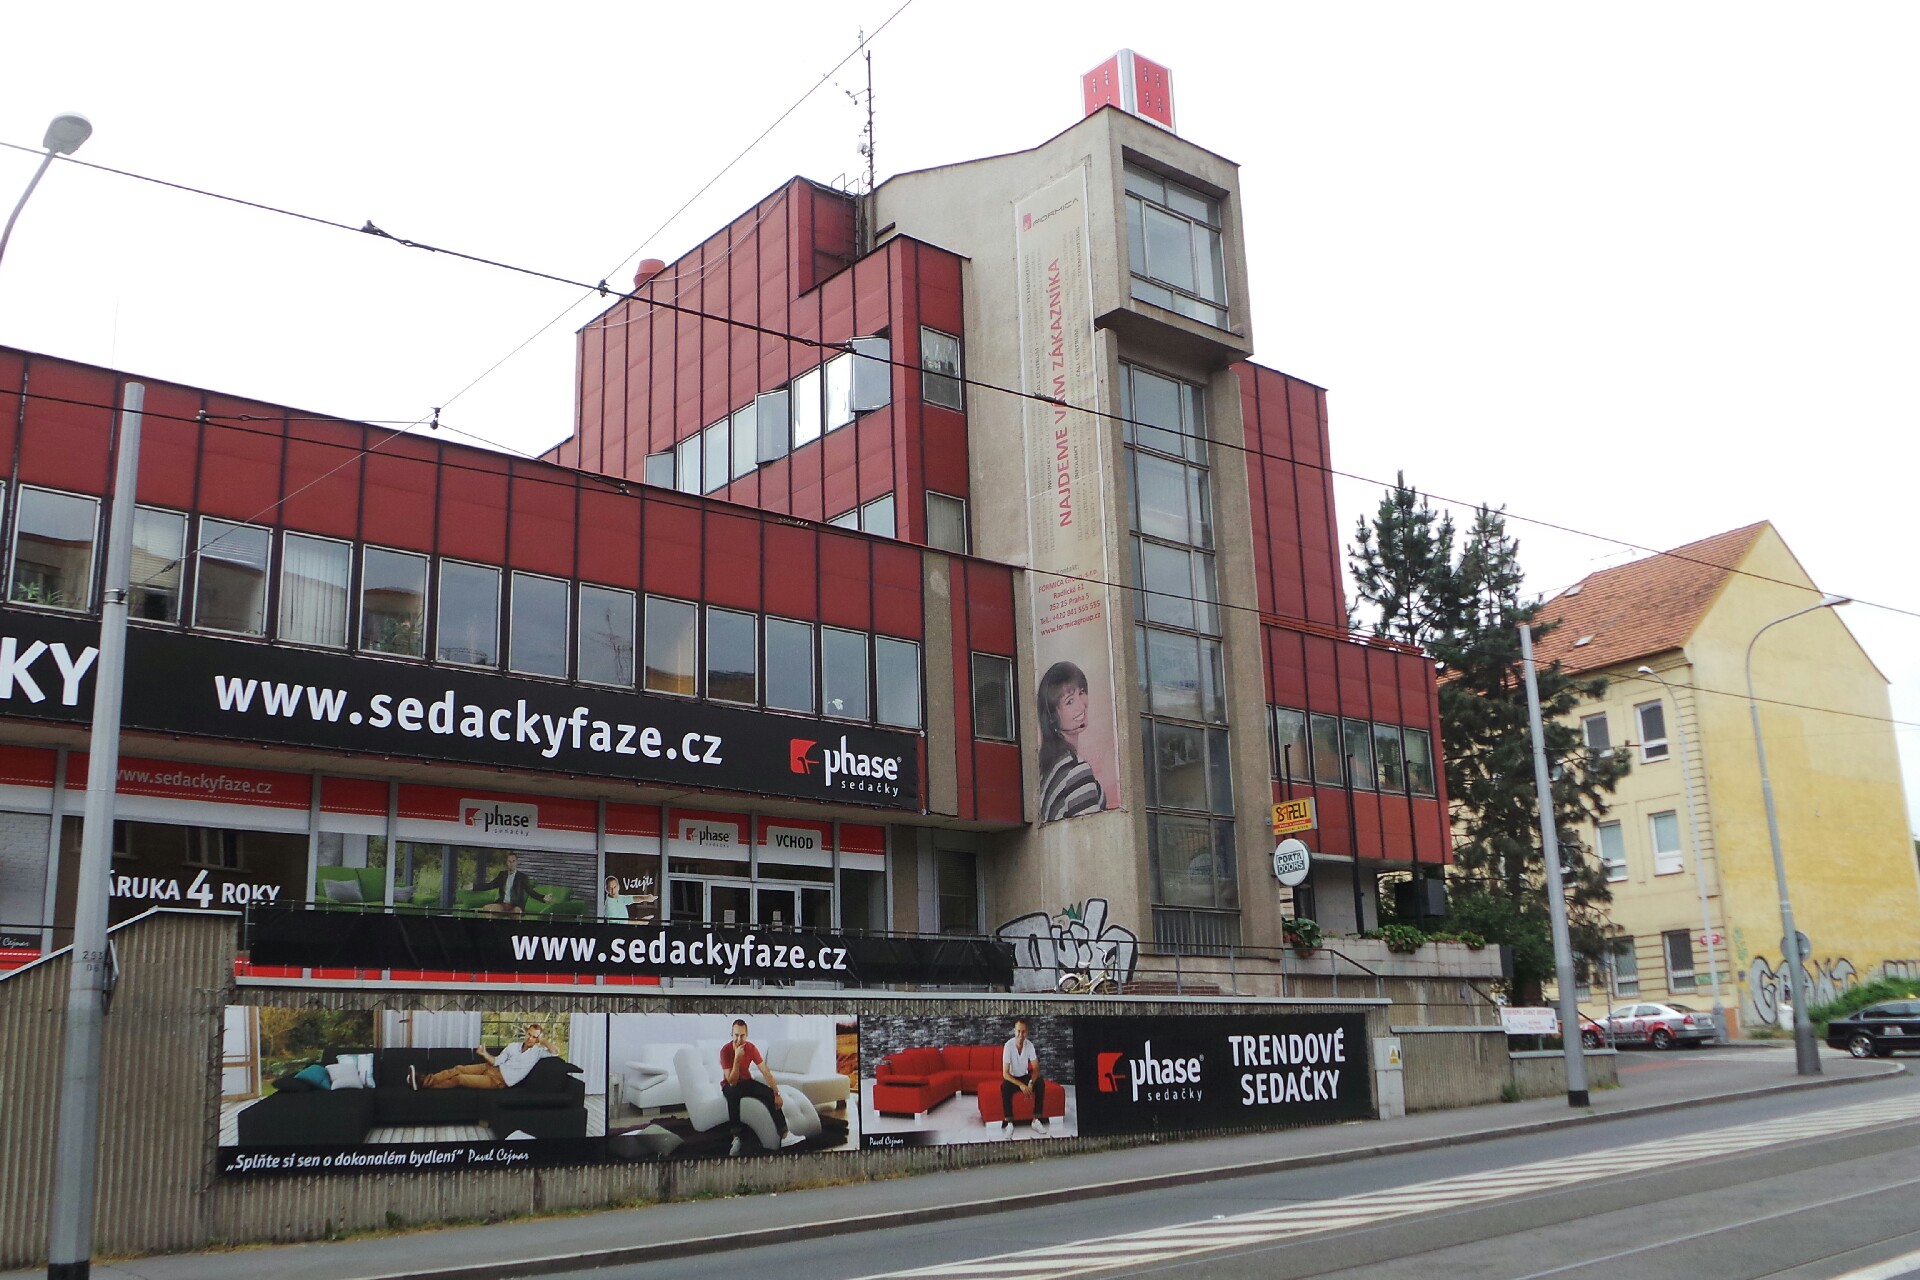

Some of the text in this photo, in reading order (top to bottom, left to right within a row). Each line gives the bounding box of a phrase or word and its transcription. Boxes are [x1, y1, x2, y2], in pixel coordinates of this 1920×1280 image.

[1033, 197, 1079, 227] FORMICA
[1045, 257, 1064, 372] ZÁKAZNÍKA
[1055, 426, 1073, 528] NAJDEME
[1038, 580, 1064, 593] FORMICA
[1069, 595, 1085, 605] Praha
[1085, 592, 1090, 600] 5
[0, 636, 100, 706] KY
[214, 675, 723, 765] www.sedackyfaze.cz
[116, 768, 272, 794] www.sedackyfaze.cz
[841, 780, 899, 797] sedačky
[485, 804, 530, 832] phase
[699, 825, 730, 846] phase
[775, 834, 814, 850] VCHOD
[1278, 862, 1304, 874] DOORS
[109, 869, 281, 908] ÁRUKA 4 ROKY
[511, 930, 848, 975] www.sedackyfaze.cz
[1228, 1026, 1346, 1067] TRENDOVÉ
[1148, 1087, 1203, 1102] sedačky
[1241, 1065, 1341, 1106] SEDAČKY
[282, 1152, 296, 1168] si
[297, 1155, 320, 1167] sen
[323, 1156, 333, 1167] o
[334, 1150, 407, 1166] dokonalém
[468, 1148, 494, 1163] Pavel
[496, 1148, 529, 1165] Cejnar
